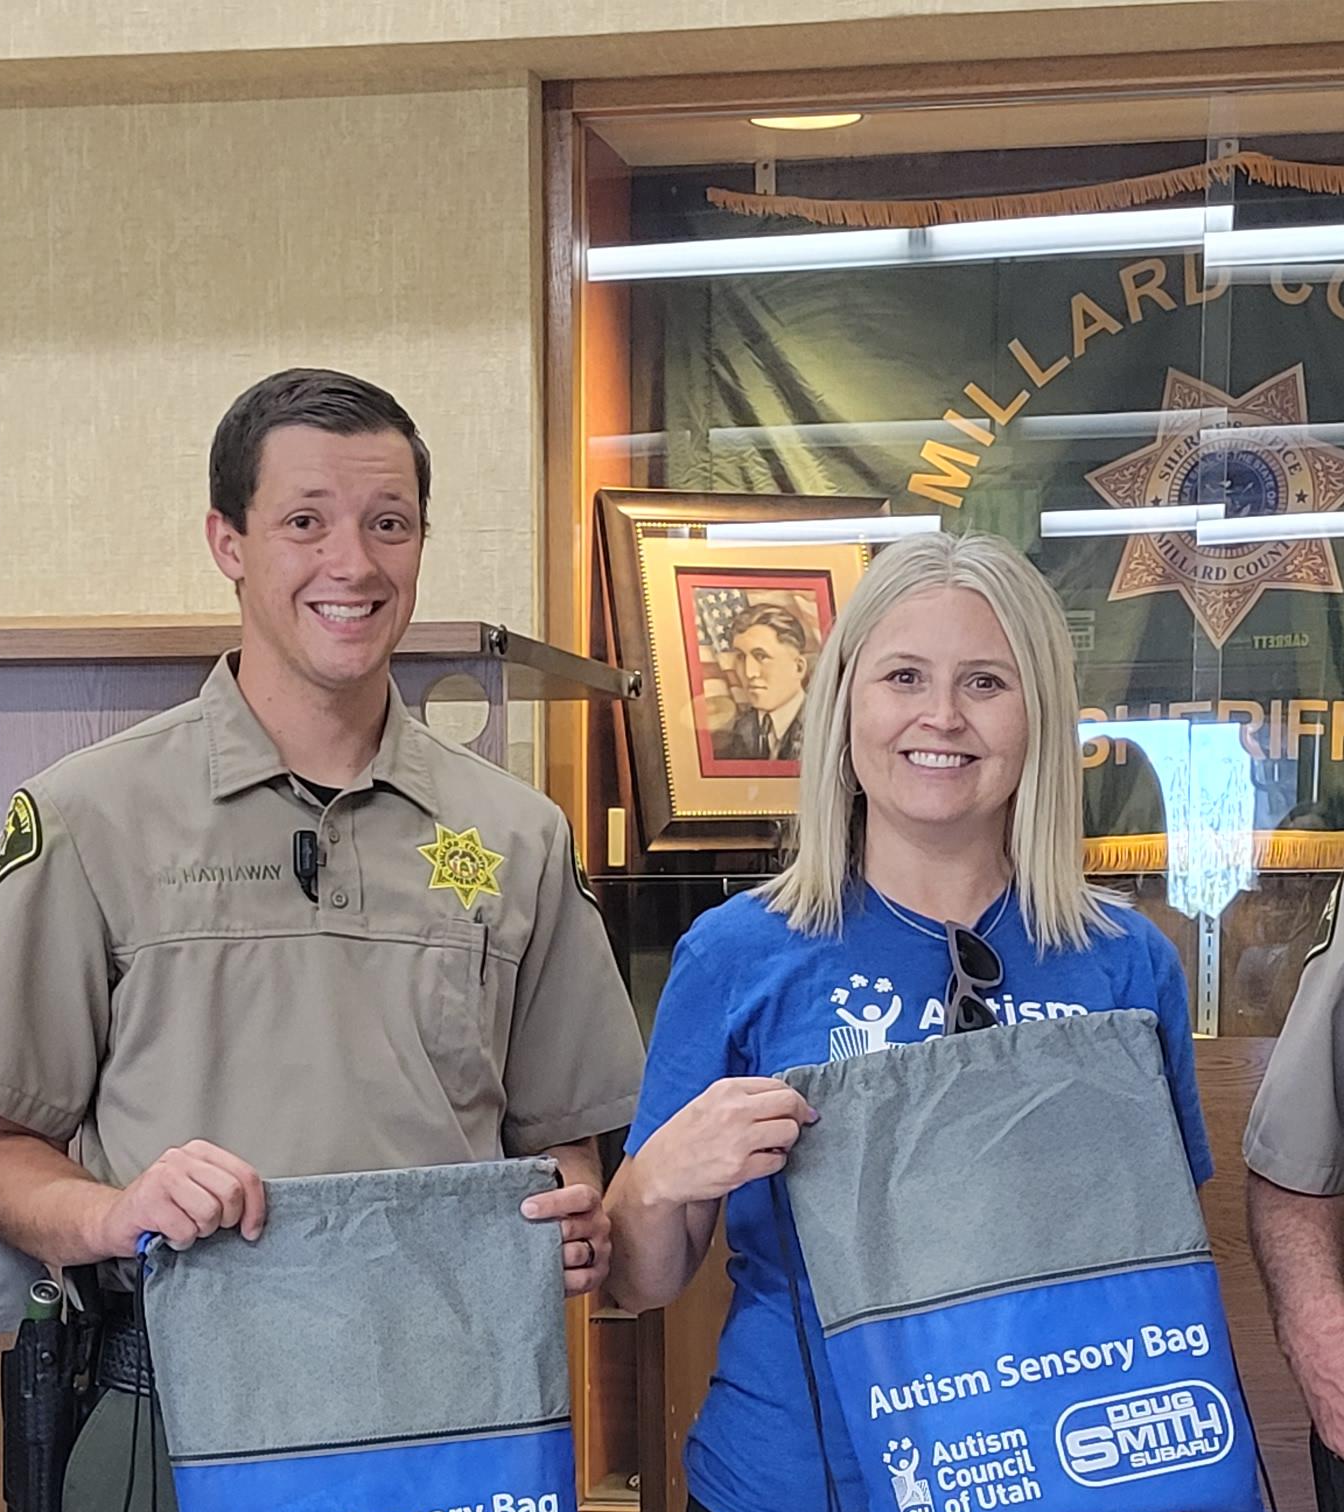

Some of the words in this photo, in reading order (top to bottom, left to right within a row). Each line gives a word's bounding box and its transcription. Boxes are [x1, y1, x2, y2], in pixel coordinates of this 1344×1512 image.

[907, 253, 1232, 509] MILLARD
[1154, 533, 1227, 580] MILLARD
[1233, 541, 1291, 579] COUNT
[183, 864, 281, 883] HATHAWAY
[918, 994, 1088, 1030] Atism
[869, 1369, 991, 1419] Autism
[996, 1336, 1135, 1387] Sensory
[1140, 1322, 1210, 1359] Bag
[1106, 1390, 1195, 1425] DOUG
[931, 1428, 1028, 1467] Autism
[1064, 1402, 1224, 1474] SMITH
[1129, 1436, 1221, 1470] SUBARU
[936, 1448, 1036, 1492] Council
[974, 1475, 1042, 1511] Utah
